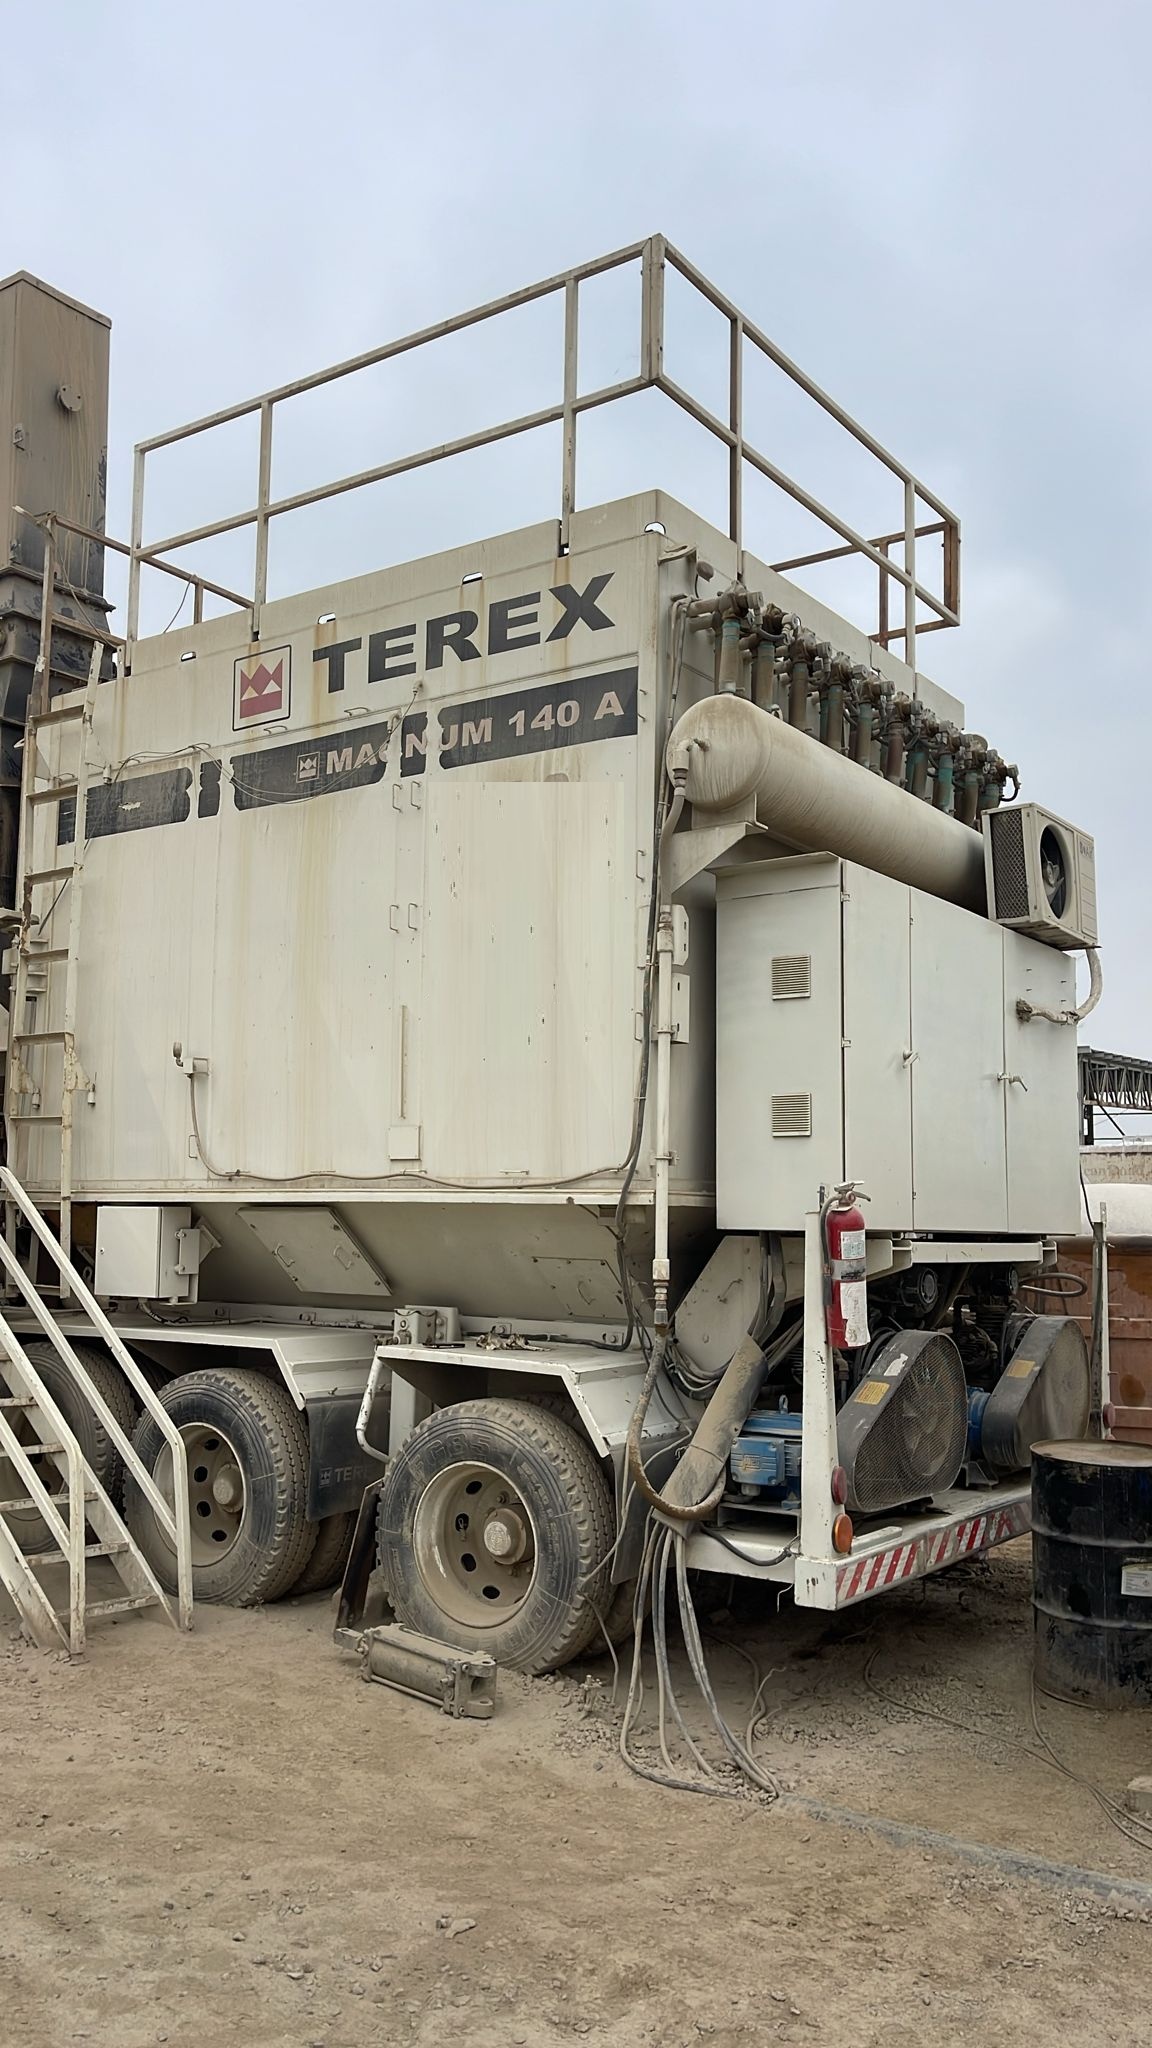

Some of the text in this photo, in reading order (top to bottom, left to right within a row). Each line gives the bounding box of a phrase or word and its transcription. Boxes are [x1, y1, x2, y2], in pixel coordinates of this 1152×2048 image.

[312, 572, 616, 694] TEREX
[509, 700, 580, 737] 140
[593, 691, 625, 721] A
